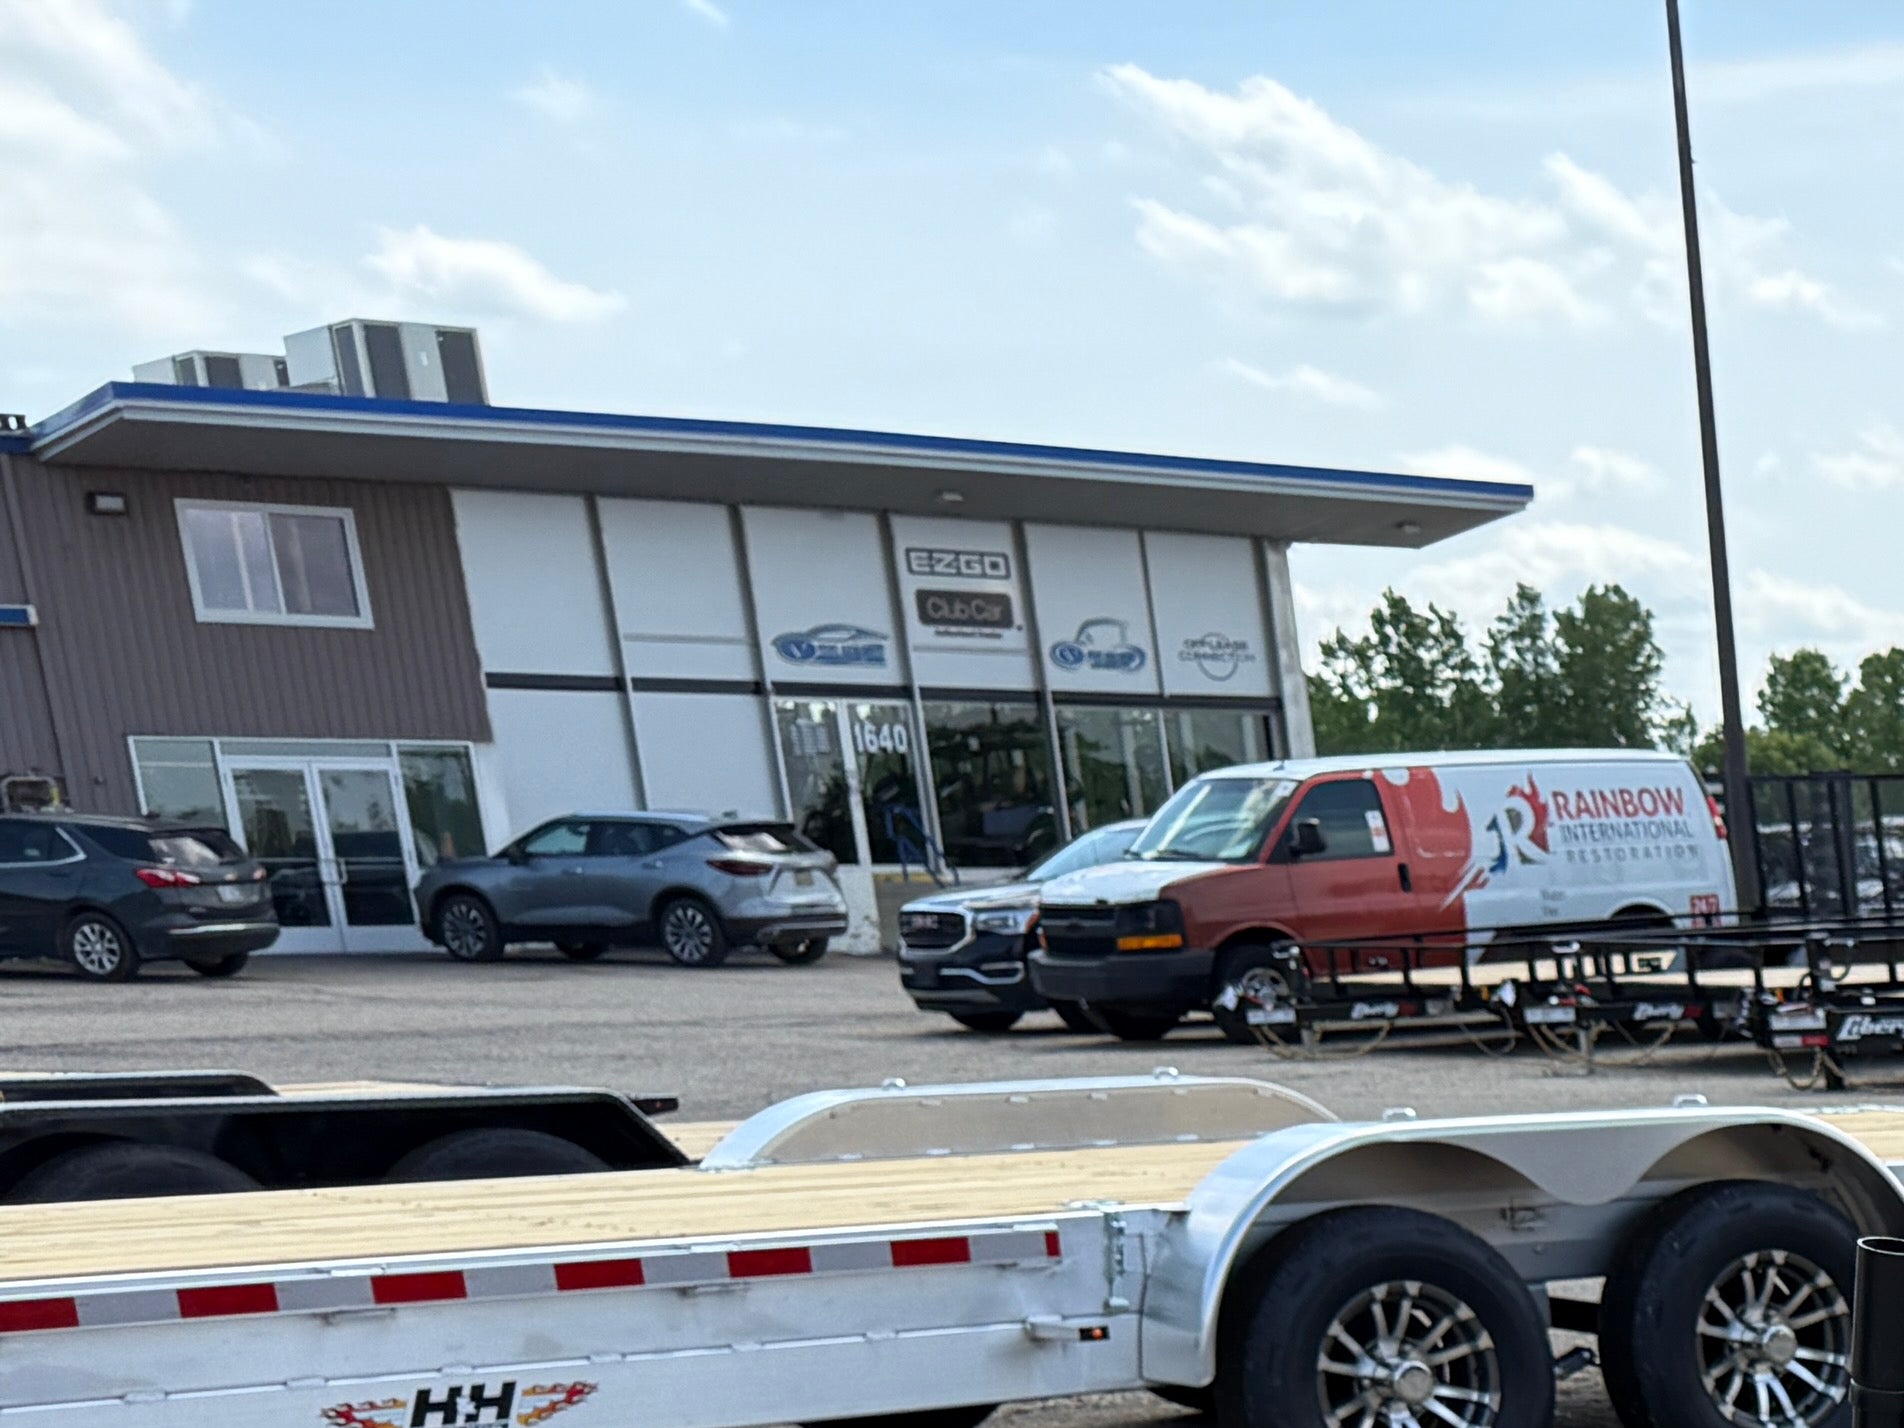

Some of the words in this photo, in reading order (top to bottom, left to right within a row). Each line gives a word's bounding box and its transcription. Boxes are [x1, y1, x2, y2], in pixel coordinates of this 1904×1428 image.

[908, 550, 1007, 576] EZGO
[854, 721, 907, 754] 1640
[1551, 786, 1686, 820] RAINBOW
[1559, 820, 1695, 843] INTERNATIONAL
[1565, 844, 1698, 865] RESTORATION
[410, 1380, 517, 1428] H&H
